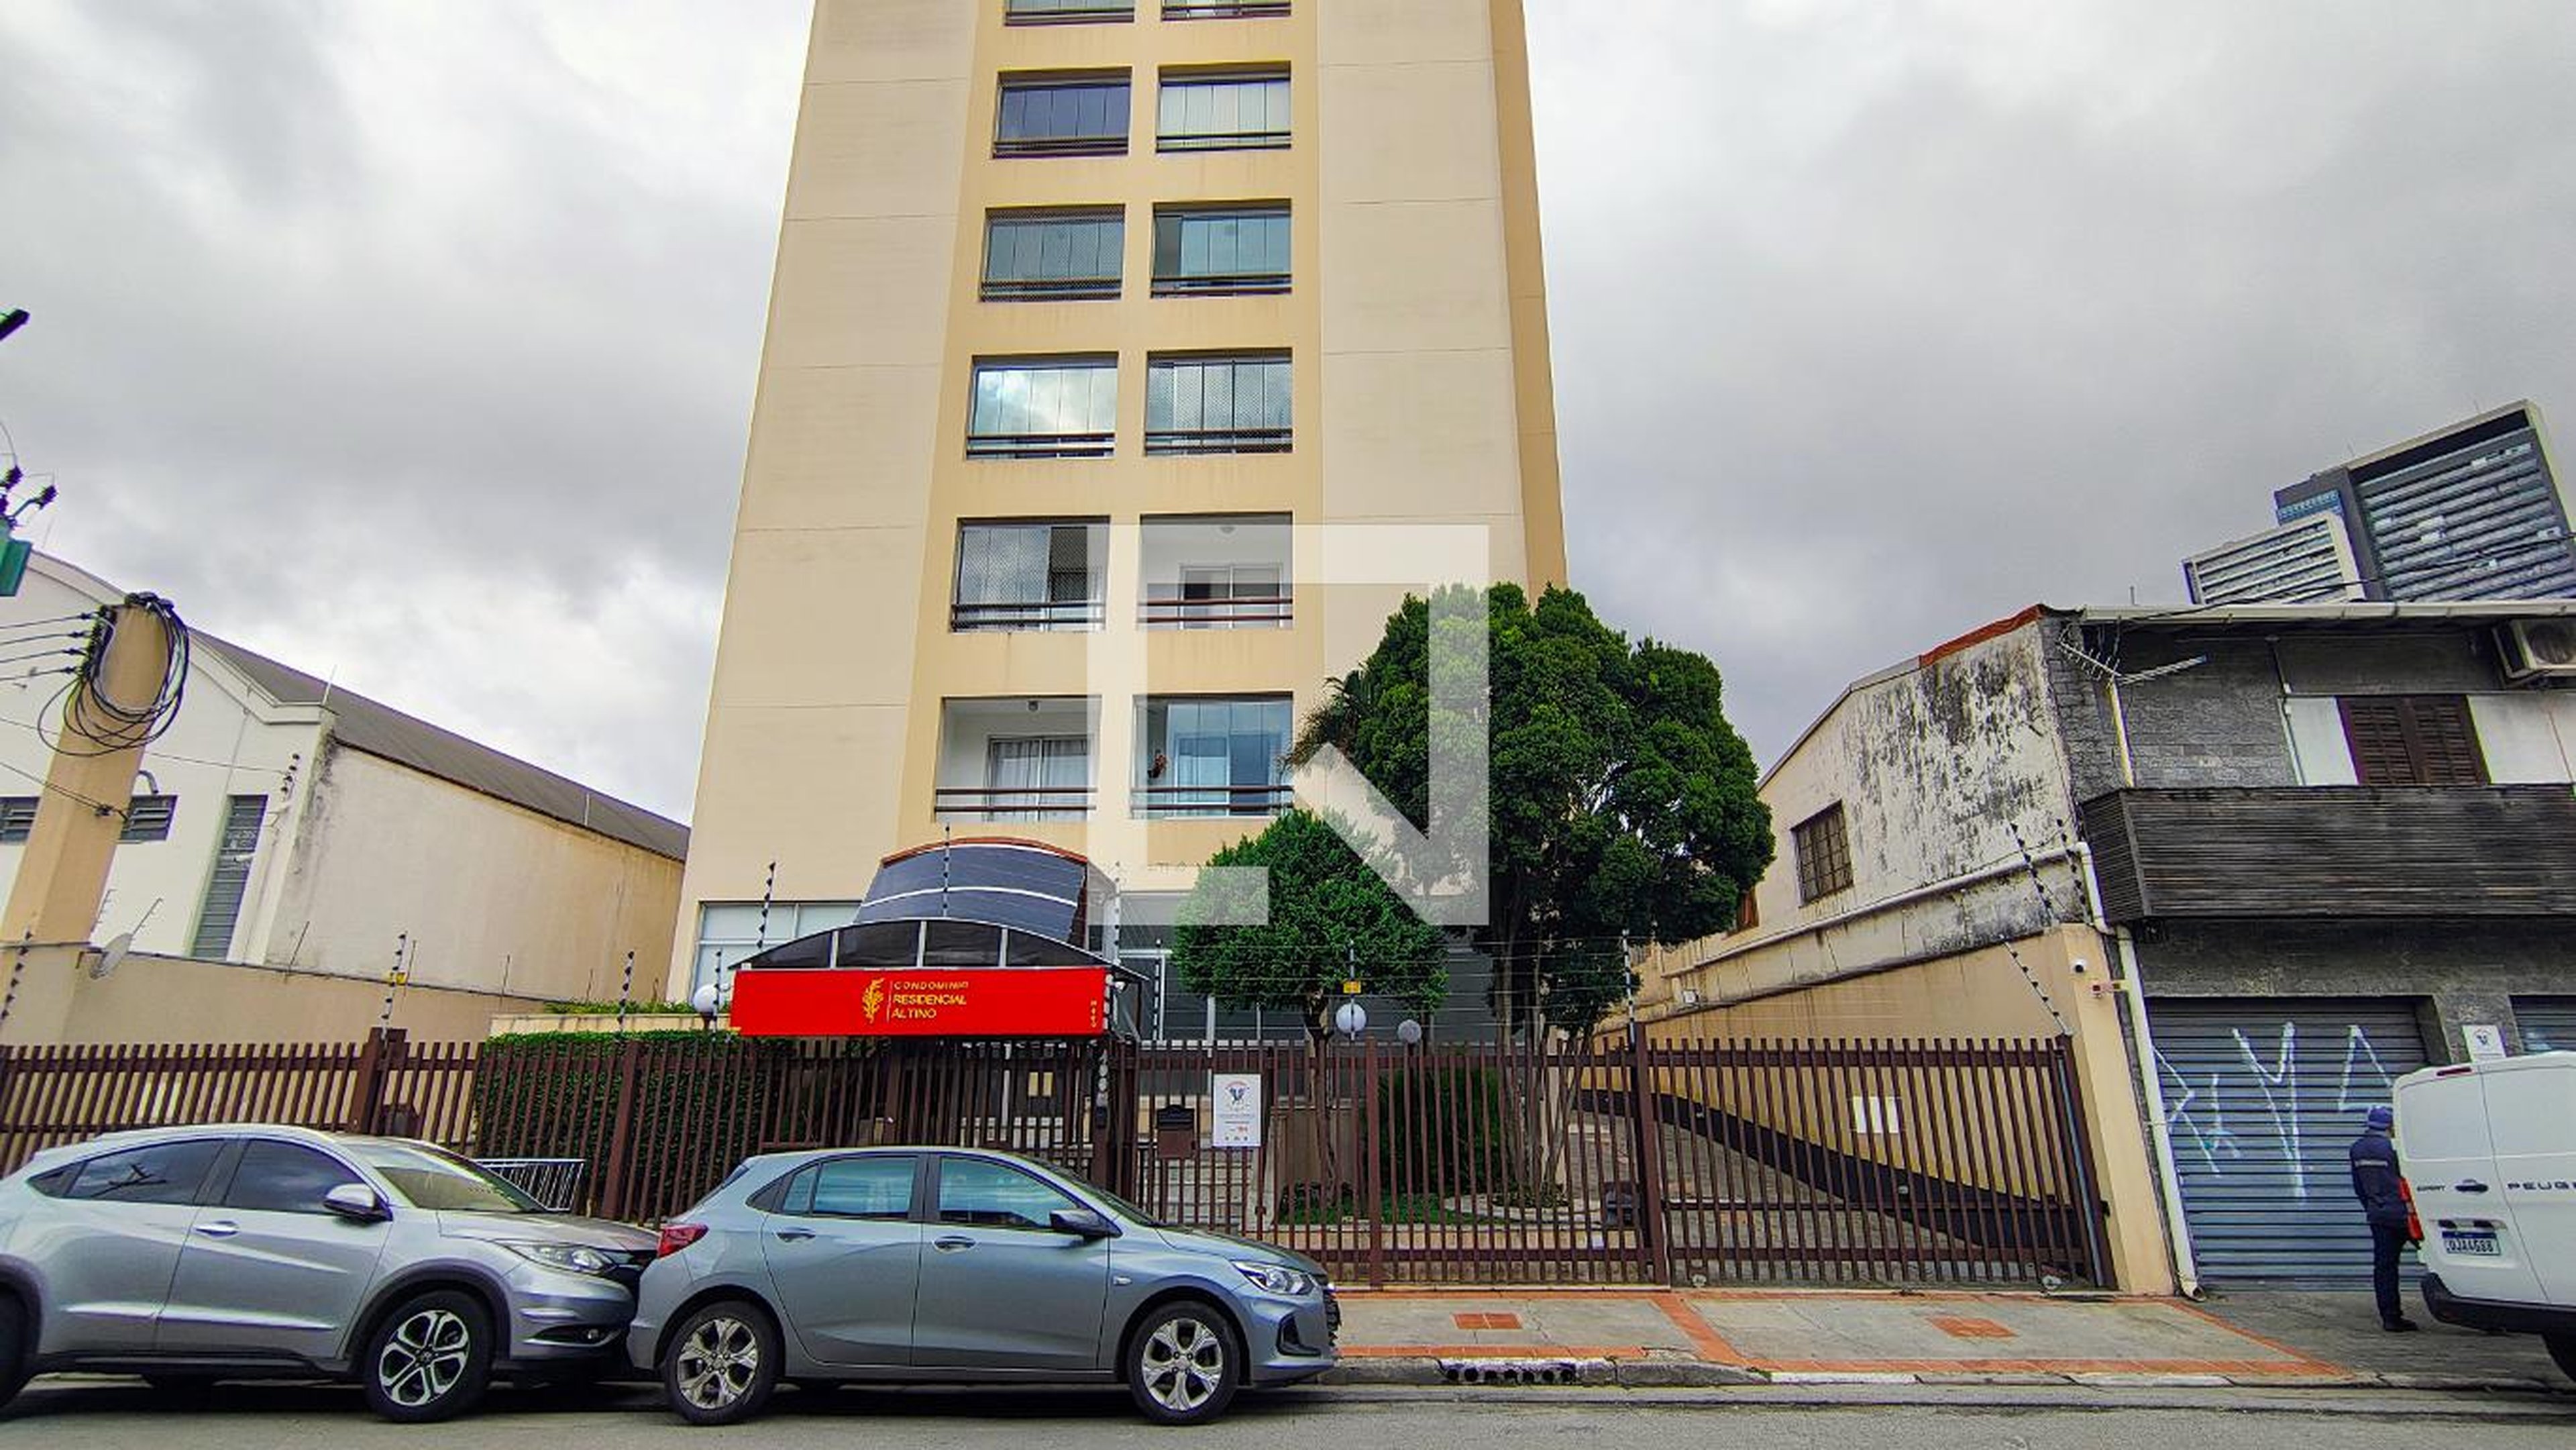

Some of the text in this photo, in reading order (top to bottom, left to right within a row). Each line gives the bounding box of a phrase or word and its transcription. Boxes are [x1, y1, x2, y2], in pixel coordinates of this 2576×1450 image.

[893, 994, 967, 1005] RESIDENCIAL
[891, 1008, 937, 1019] ALTINO
[2507, 1181, 2576, 1190] PEUG
